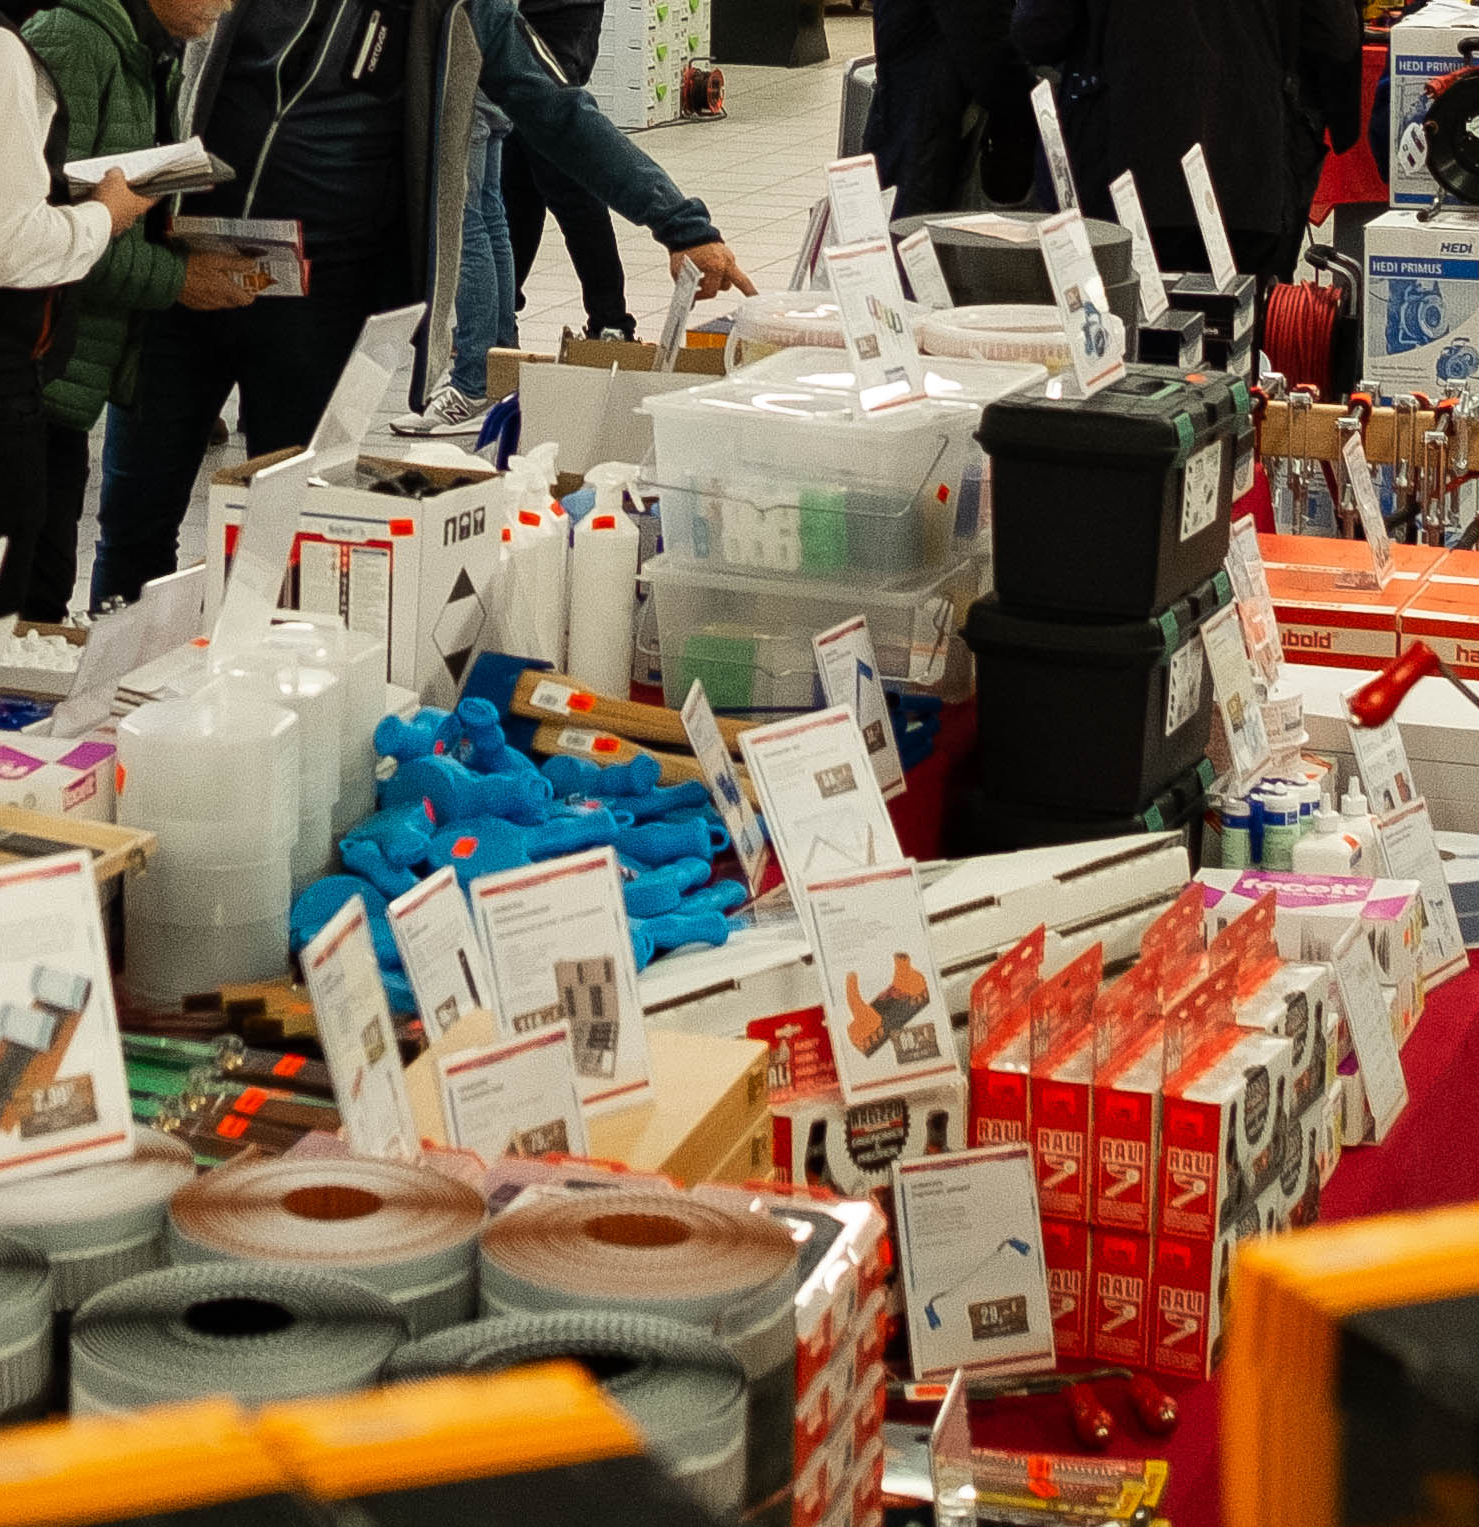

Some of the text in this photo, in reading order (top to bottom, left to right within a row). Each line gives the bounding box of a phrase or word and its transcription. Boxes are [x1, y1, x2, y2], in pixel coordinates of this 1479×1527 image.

[1398, 59, 1465, 74] HEDI PRIMU
[1440, 242, 1473, 254] HEDI
[1372, 260, 1443, 276] HEDI PRIMUS
[976, 1117, 1023, 1147] RALI
[1037, 1127, 1084, 1157] RALI
[1099, 1136, 1147, 1164] RALI
[1166, 1147, 1214, 1175] RALI
[1097, 1272, 1144, 1299] RALI
[1158, 1285, 1205, 1311] RALI
